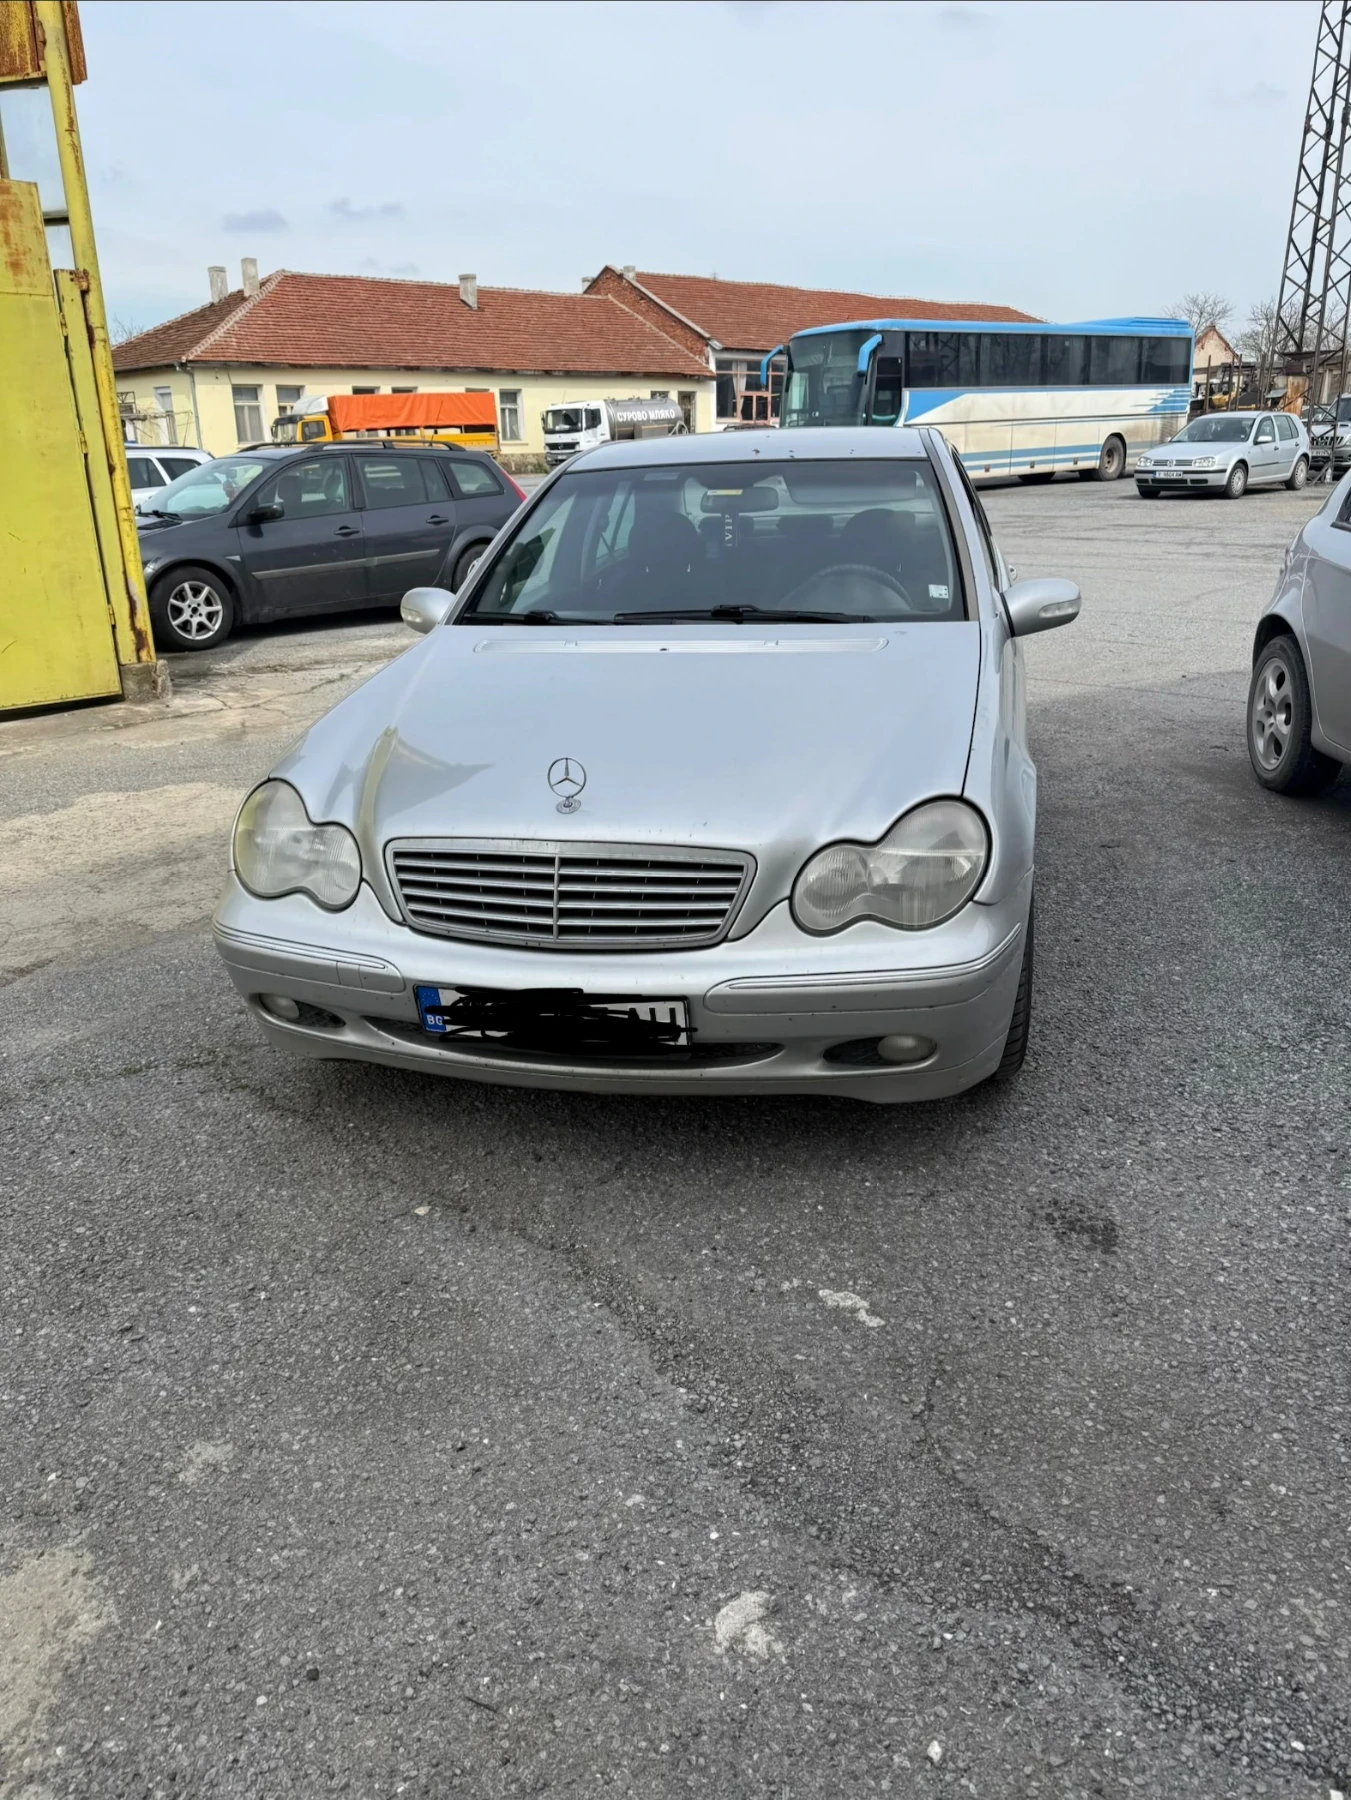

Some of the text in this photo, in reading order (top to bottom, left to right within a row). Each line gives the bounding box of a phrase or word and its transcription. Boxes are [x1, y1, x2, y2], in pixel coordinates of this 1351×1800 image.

[616, 409, 675, 421] СУРОВО МЛЯКО
[426, 1014, 443, 1026] BG
